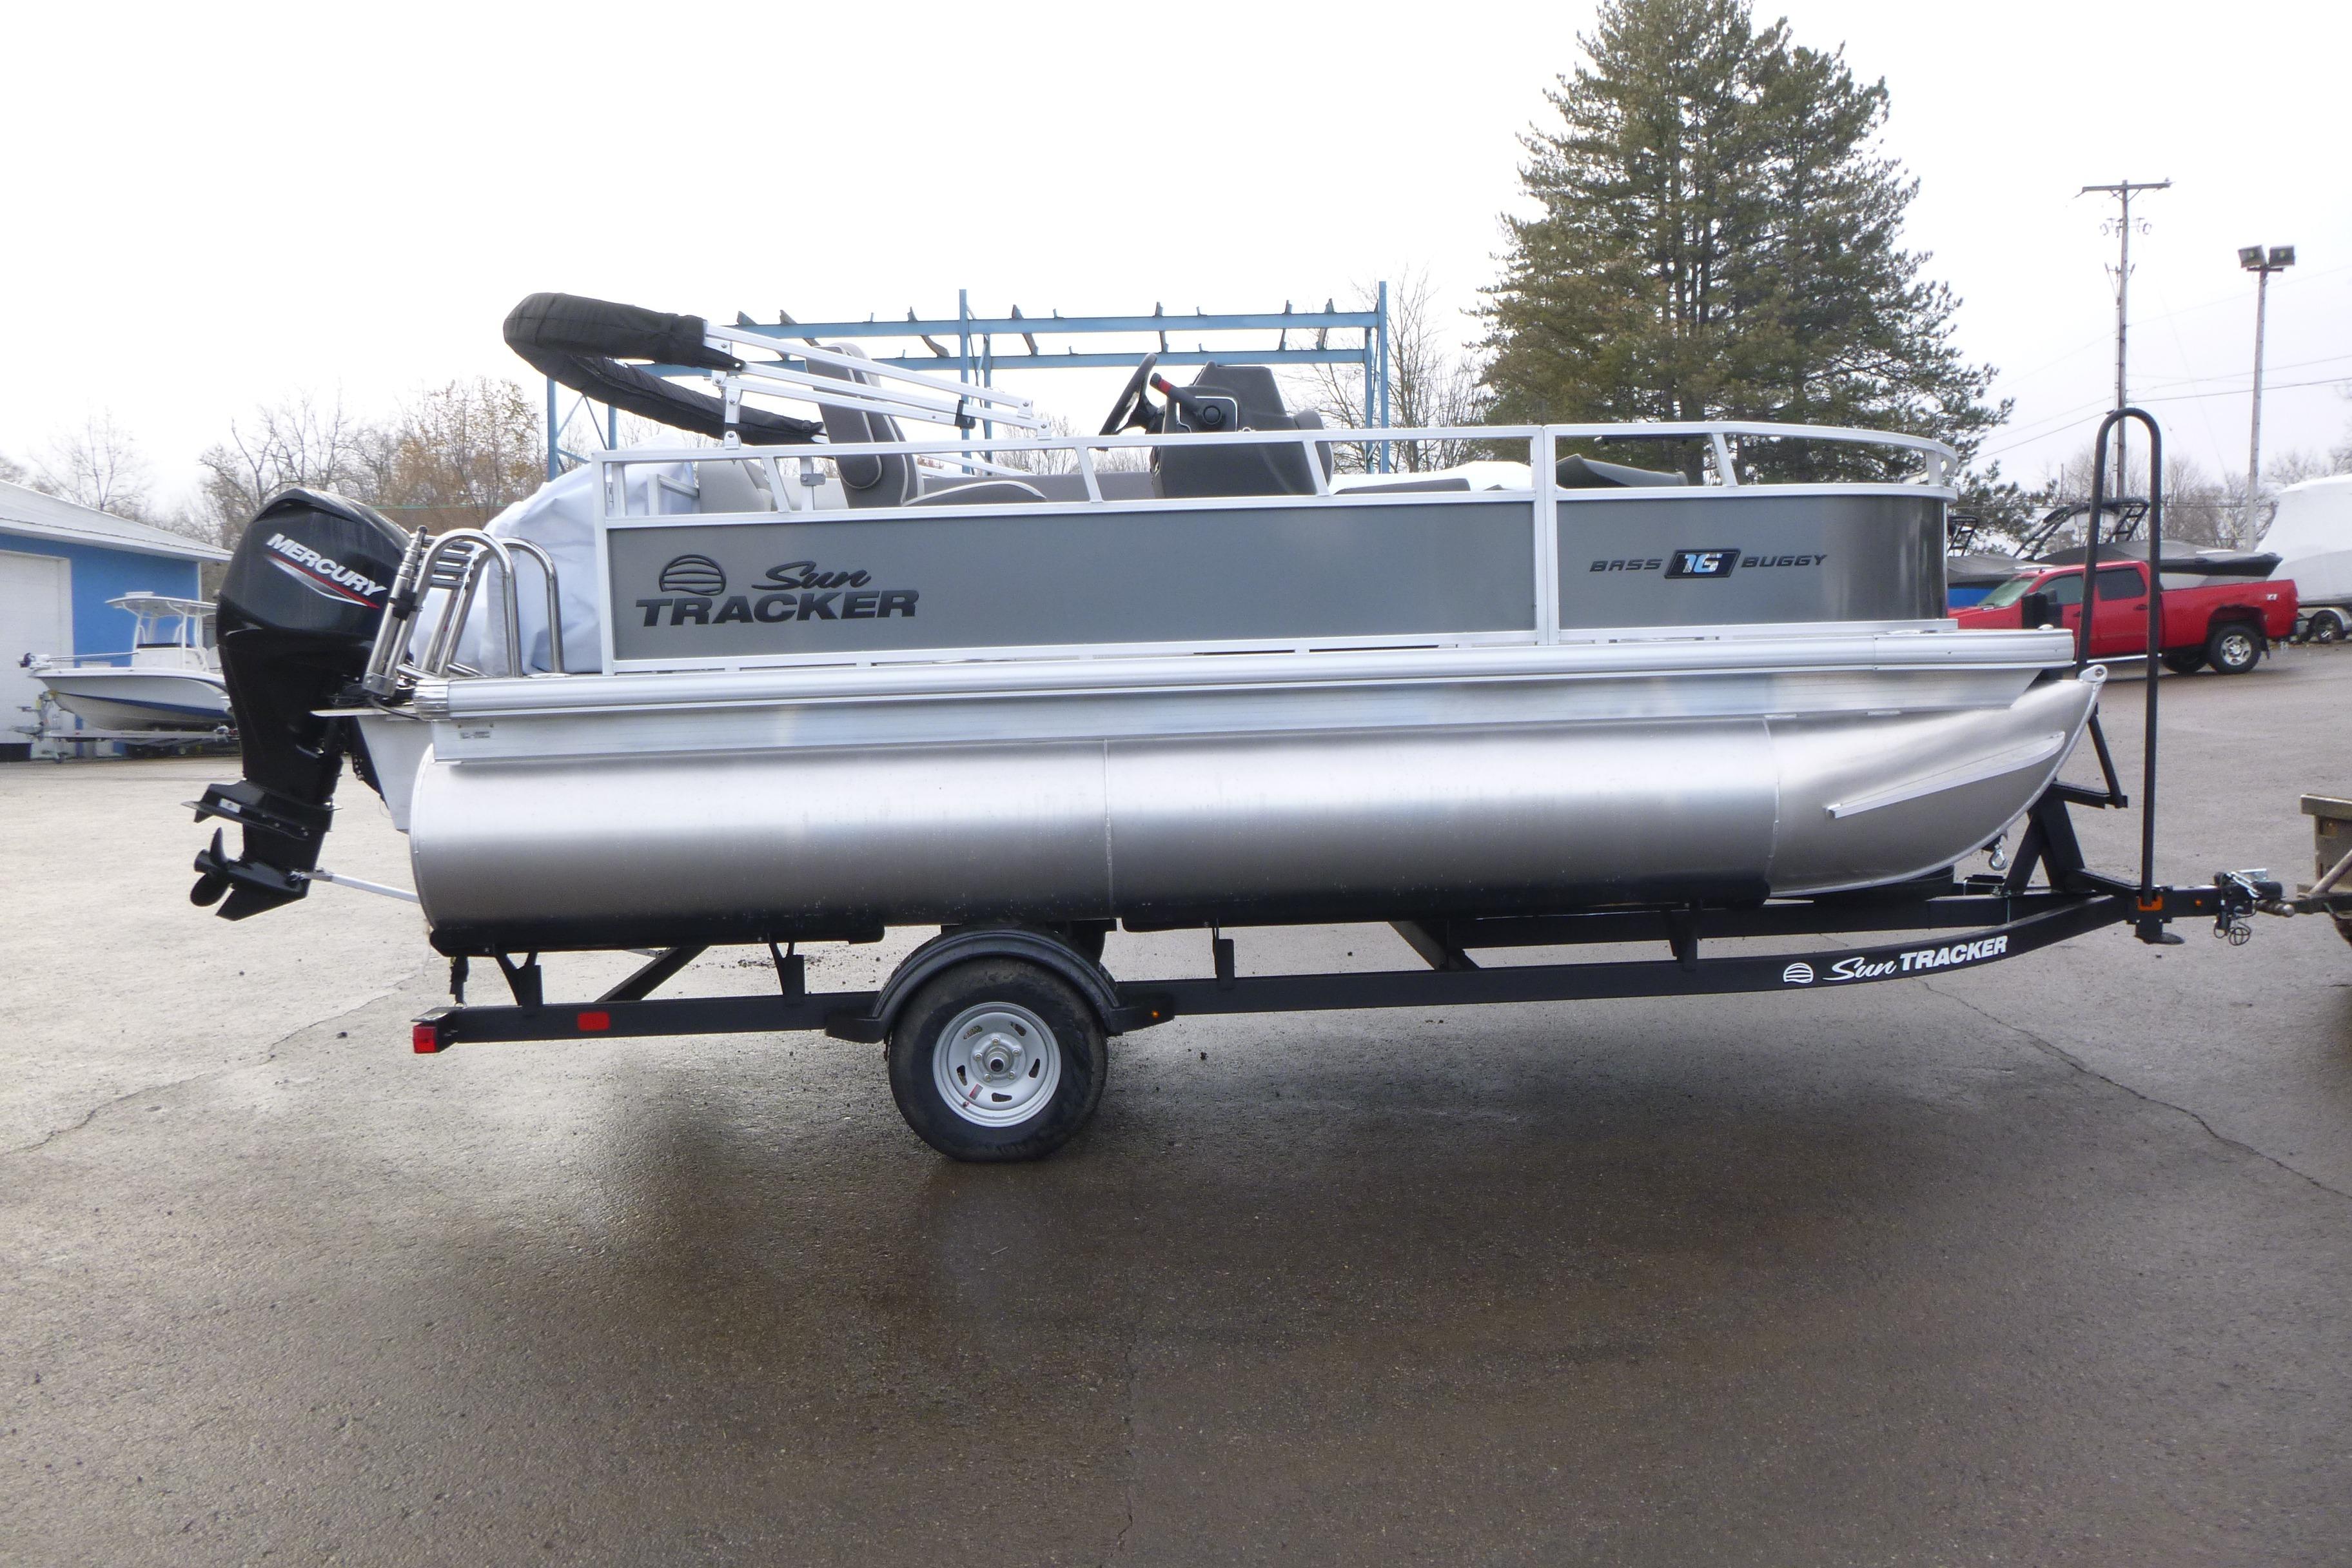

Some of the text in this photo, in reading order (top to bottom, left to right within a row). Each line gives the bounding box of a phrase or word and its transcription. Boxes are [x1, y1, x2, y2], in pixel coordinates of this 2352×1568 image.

[266, 533, 387, 596] MERCURY
[751, 561, 872, 590] Sun
[1589, 554, 1827, 573] BASS 16 BUGGY
[636, 589, 919, 627] TRACKER
[1822, 936, 2008, 981] Sun TRACKER
